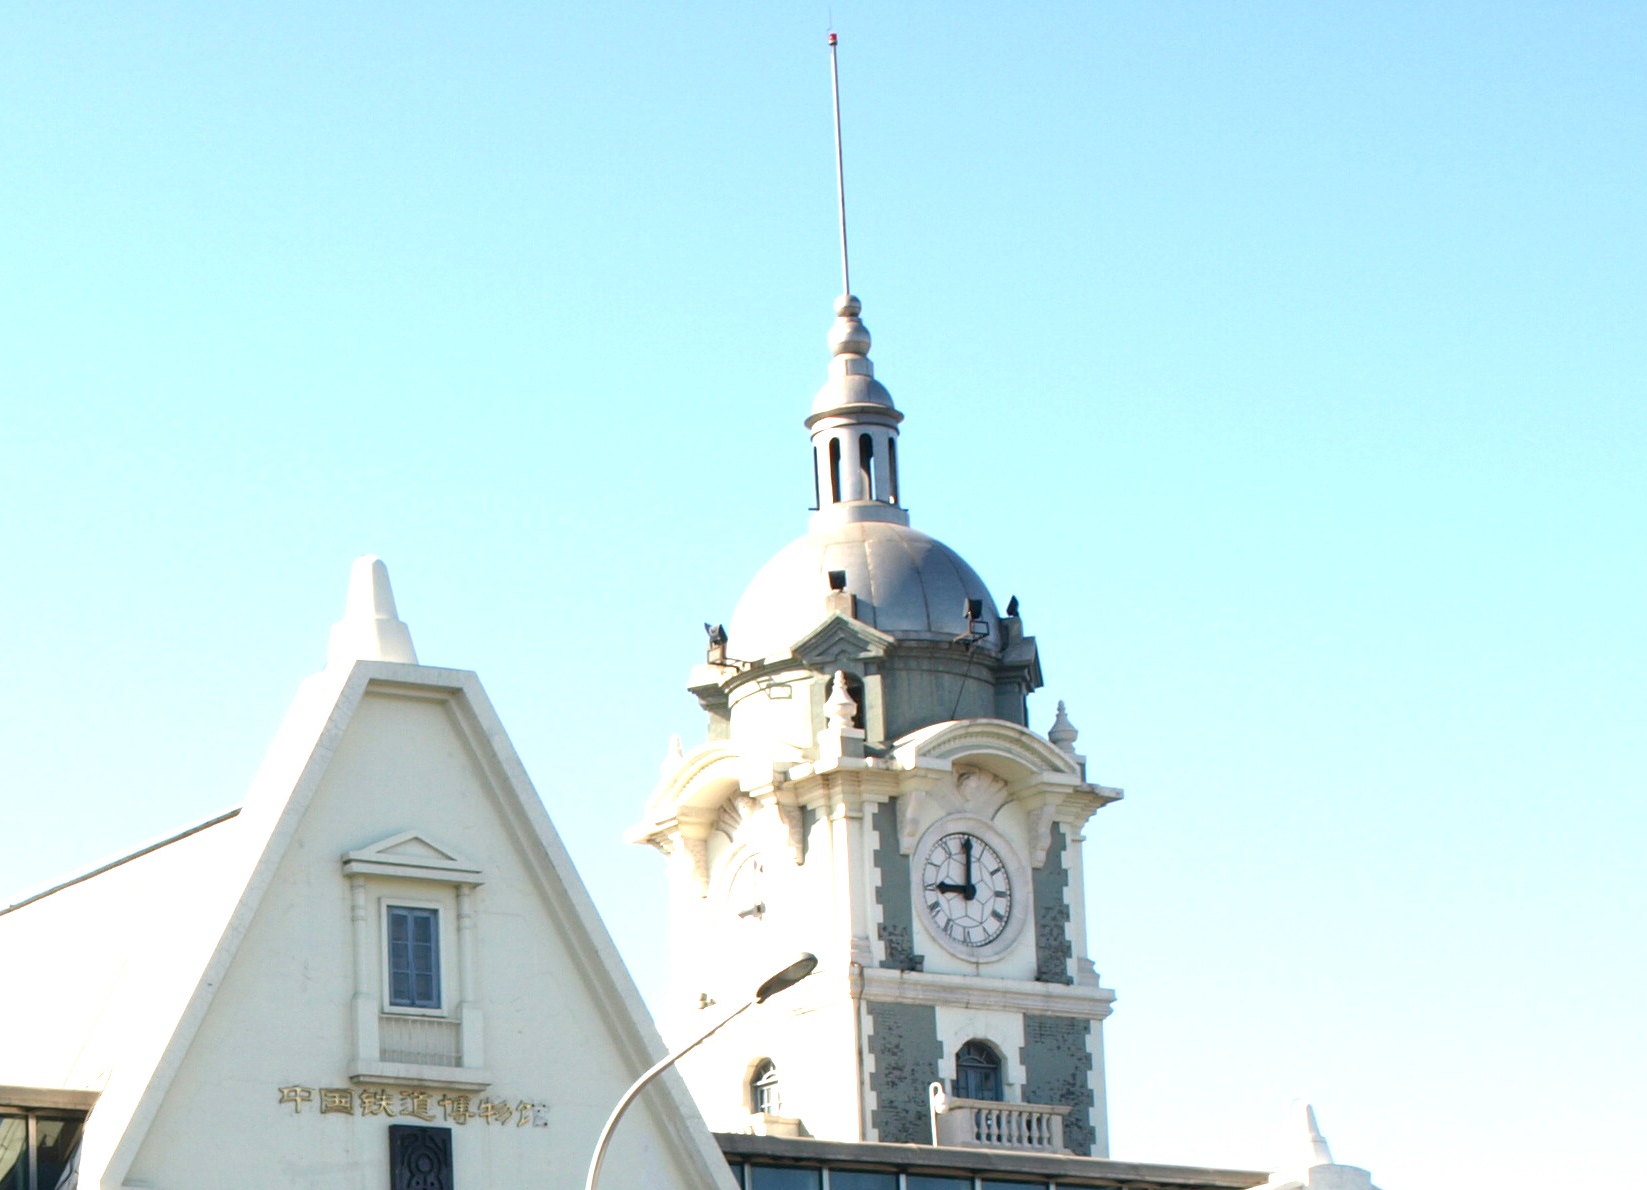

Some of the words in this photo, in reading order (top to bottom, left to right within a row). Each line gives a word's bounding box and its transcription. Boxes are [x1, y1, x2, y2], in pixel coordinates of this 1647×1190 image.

[279, 1085, 550, 1128] 中国铁道博物馆
